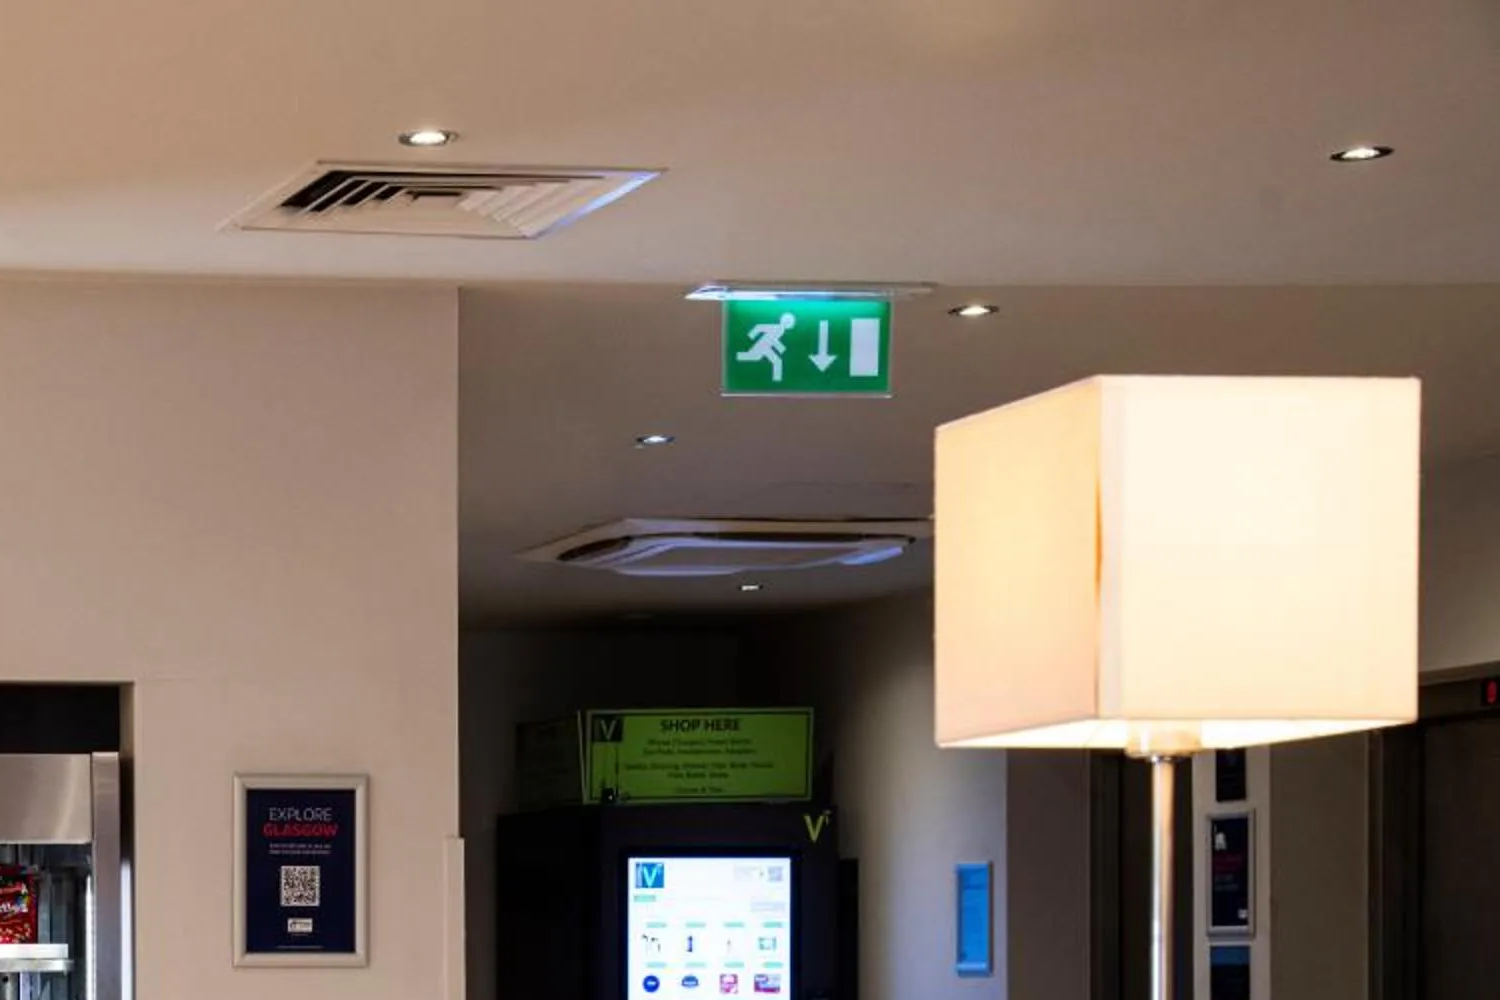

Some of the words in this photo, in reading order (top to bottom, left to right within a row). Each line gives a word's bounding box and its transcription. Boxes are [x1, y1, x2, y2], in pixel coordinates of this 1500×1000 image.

[660, 719, 700, 732] SHOP
[703, 718, 742, 732] HERE
[268, 807, 333, 822] EXPLORE
[262, 823, 340, 838] GLASGOW
